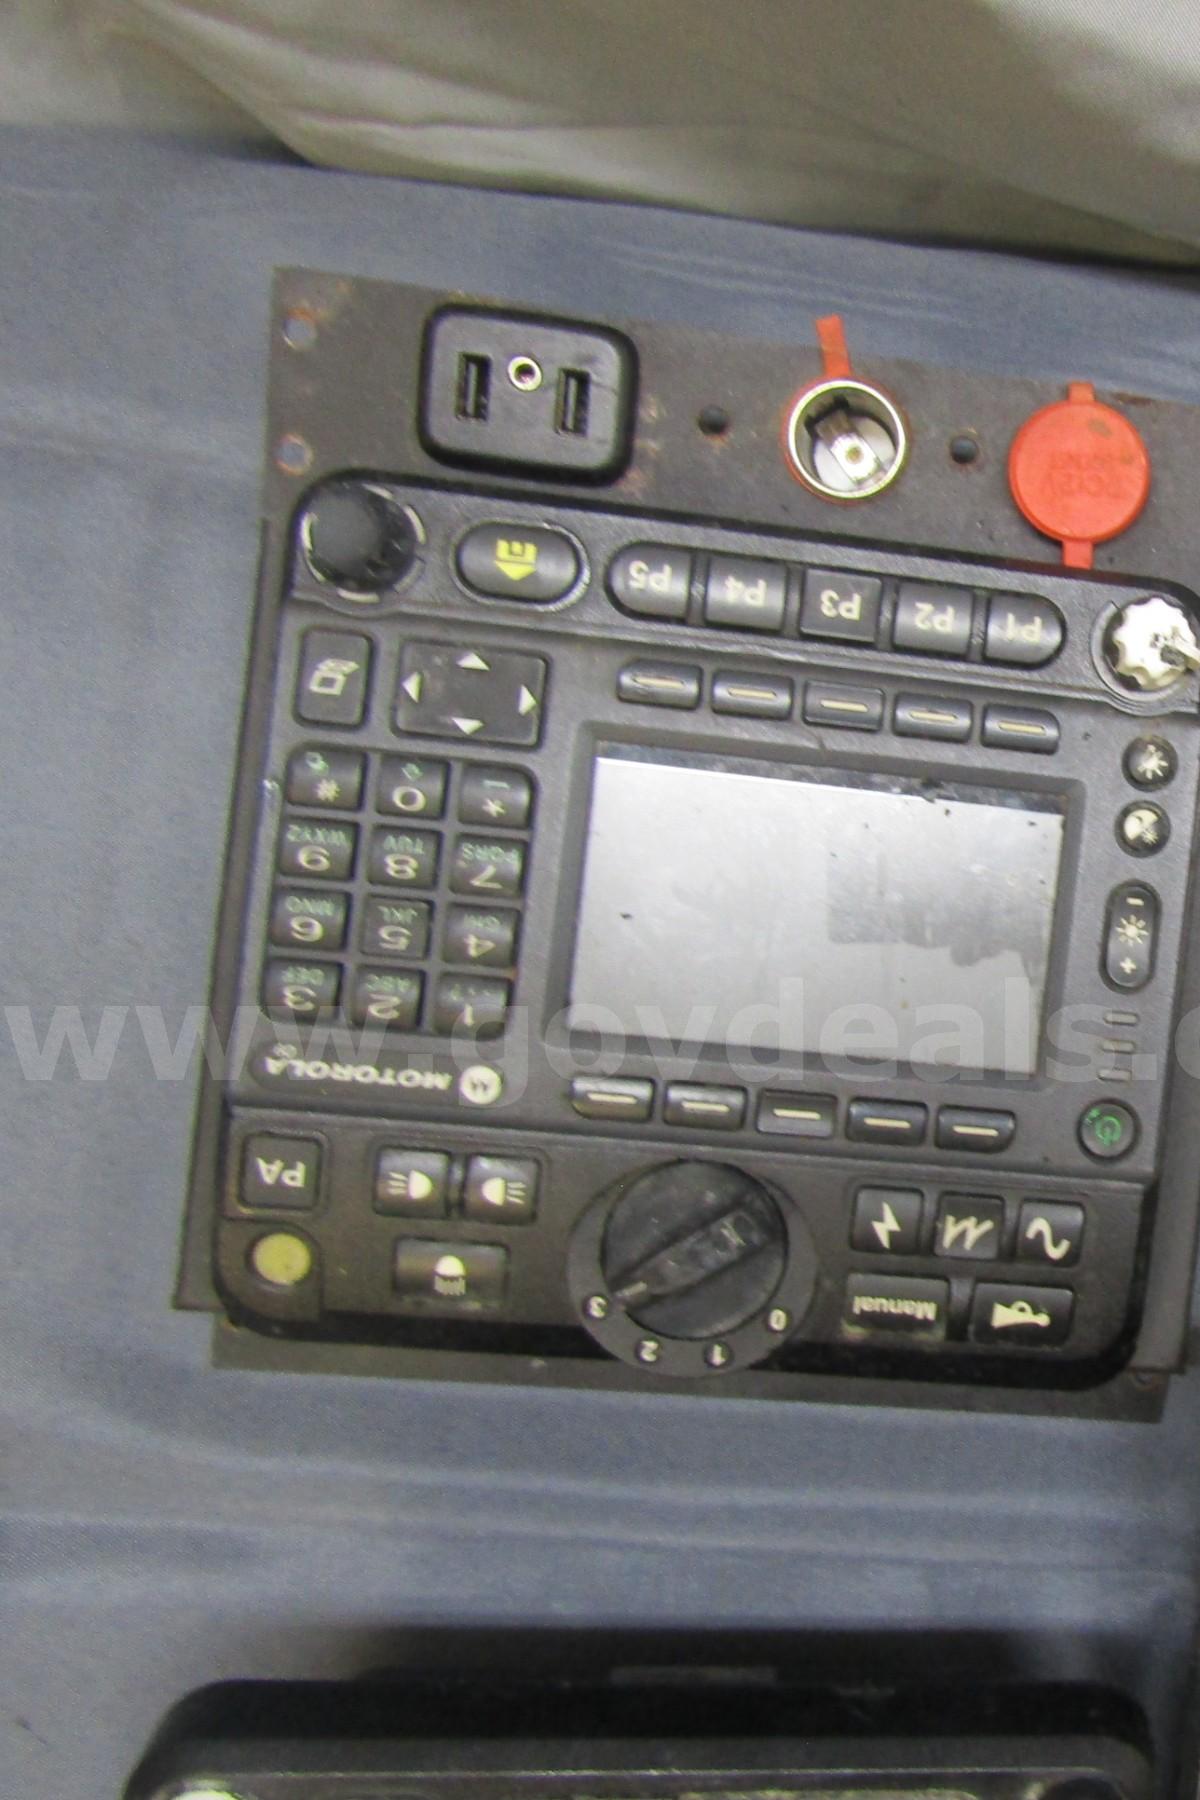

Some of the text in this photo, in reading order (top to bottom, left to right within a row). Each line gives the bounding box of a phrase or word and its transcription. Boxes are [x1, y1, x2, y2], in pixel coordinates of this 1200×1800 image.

[629, 562, 1042, 641] P1 P2 P3 P4 P5
[392, 786, 426, 812] 0
[299, 845, 331, 871] 9
[385, 853, 419, 879] 8
[469, 864, 504, 889] 7
[289, 917, 323, 942] 6
[378, 924, 412, 950] 5
[466, 933, 496, 958] 4
[282, 985, 316, 1011] 3
[368, 992, 400, 1019] 2
[463, 1004, 474, 1026] 1
[265, 1058, 451, 1089] MOTOROLA
[257, 1157, 306, 1187] PA
[589, 1296, 607, 1317] 3
[853, 1296, 937, 1320] Manual
[769, 1309, 786, 1330] 0
[640, 1341, 658, 1362] 2
[712, 1345, 724, 1366] 1
